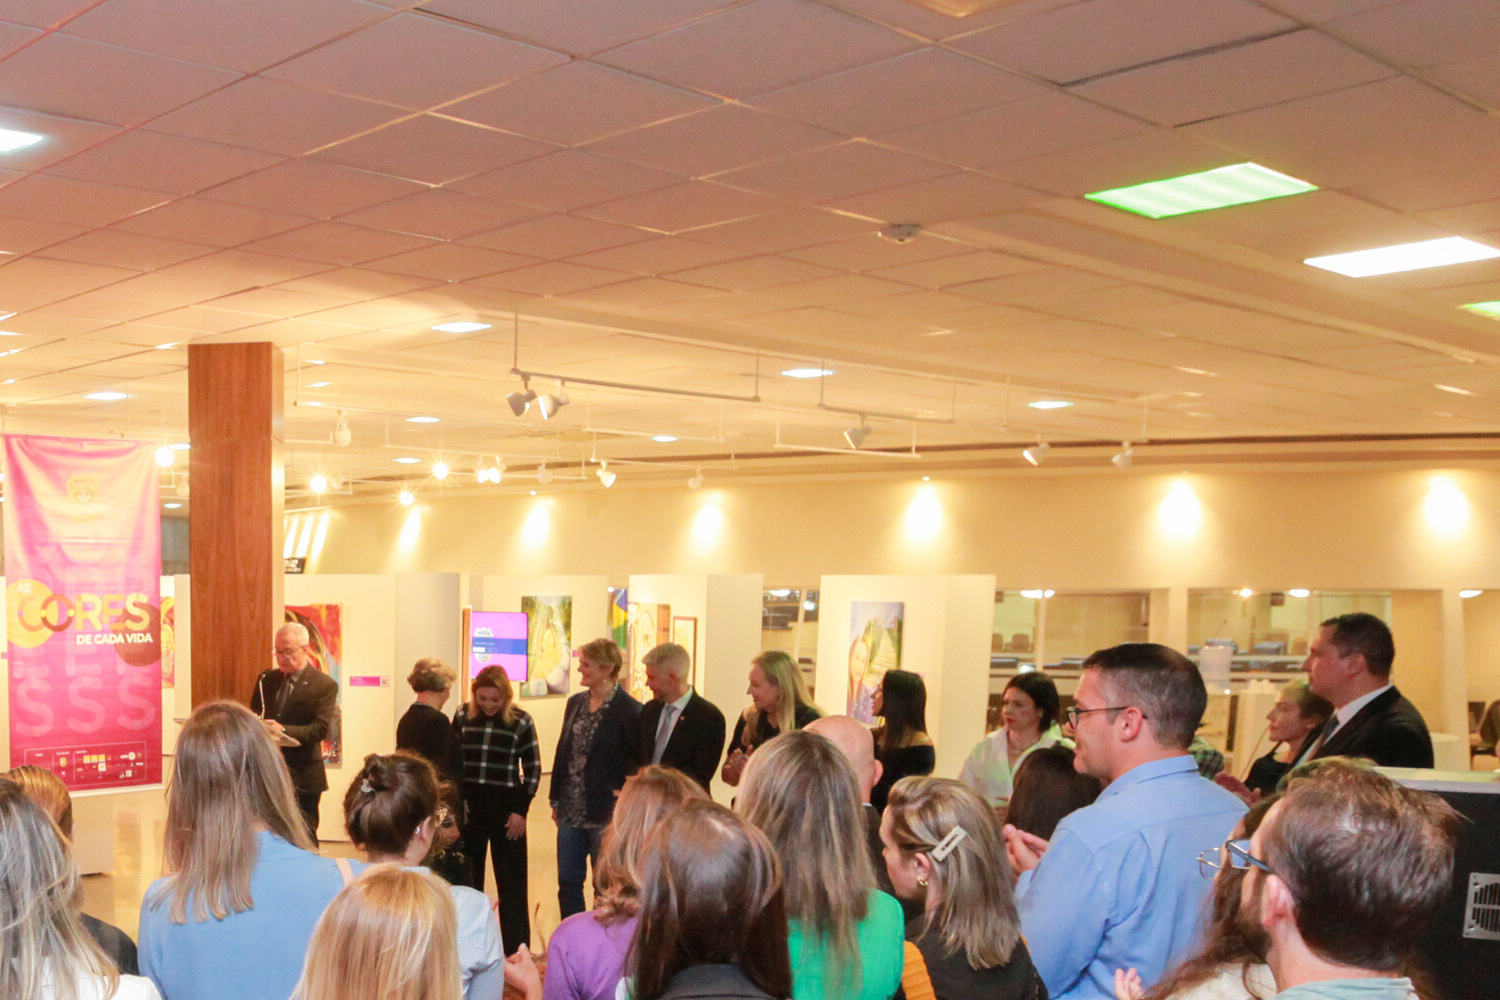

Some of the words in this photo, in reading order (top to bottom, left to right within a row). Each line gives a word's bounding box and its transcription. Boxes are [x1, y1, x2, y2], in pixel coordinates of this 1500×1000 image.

[17, 583, 32, 593] AS
[17, 593, 151, 633] CORES
[76, 634, 92, 645] DE
[94, 633, 124, 645] CADA
[125, 632, 153, 644] VIDA
